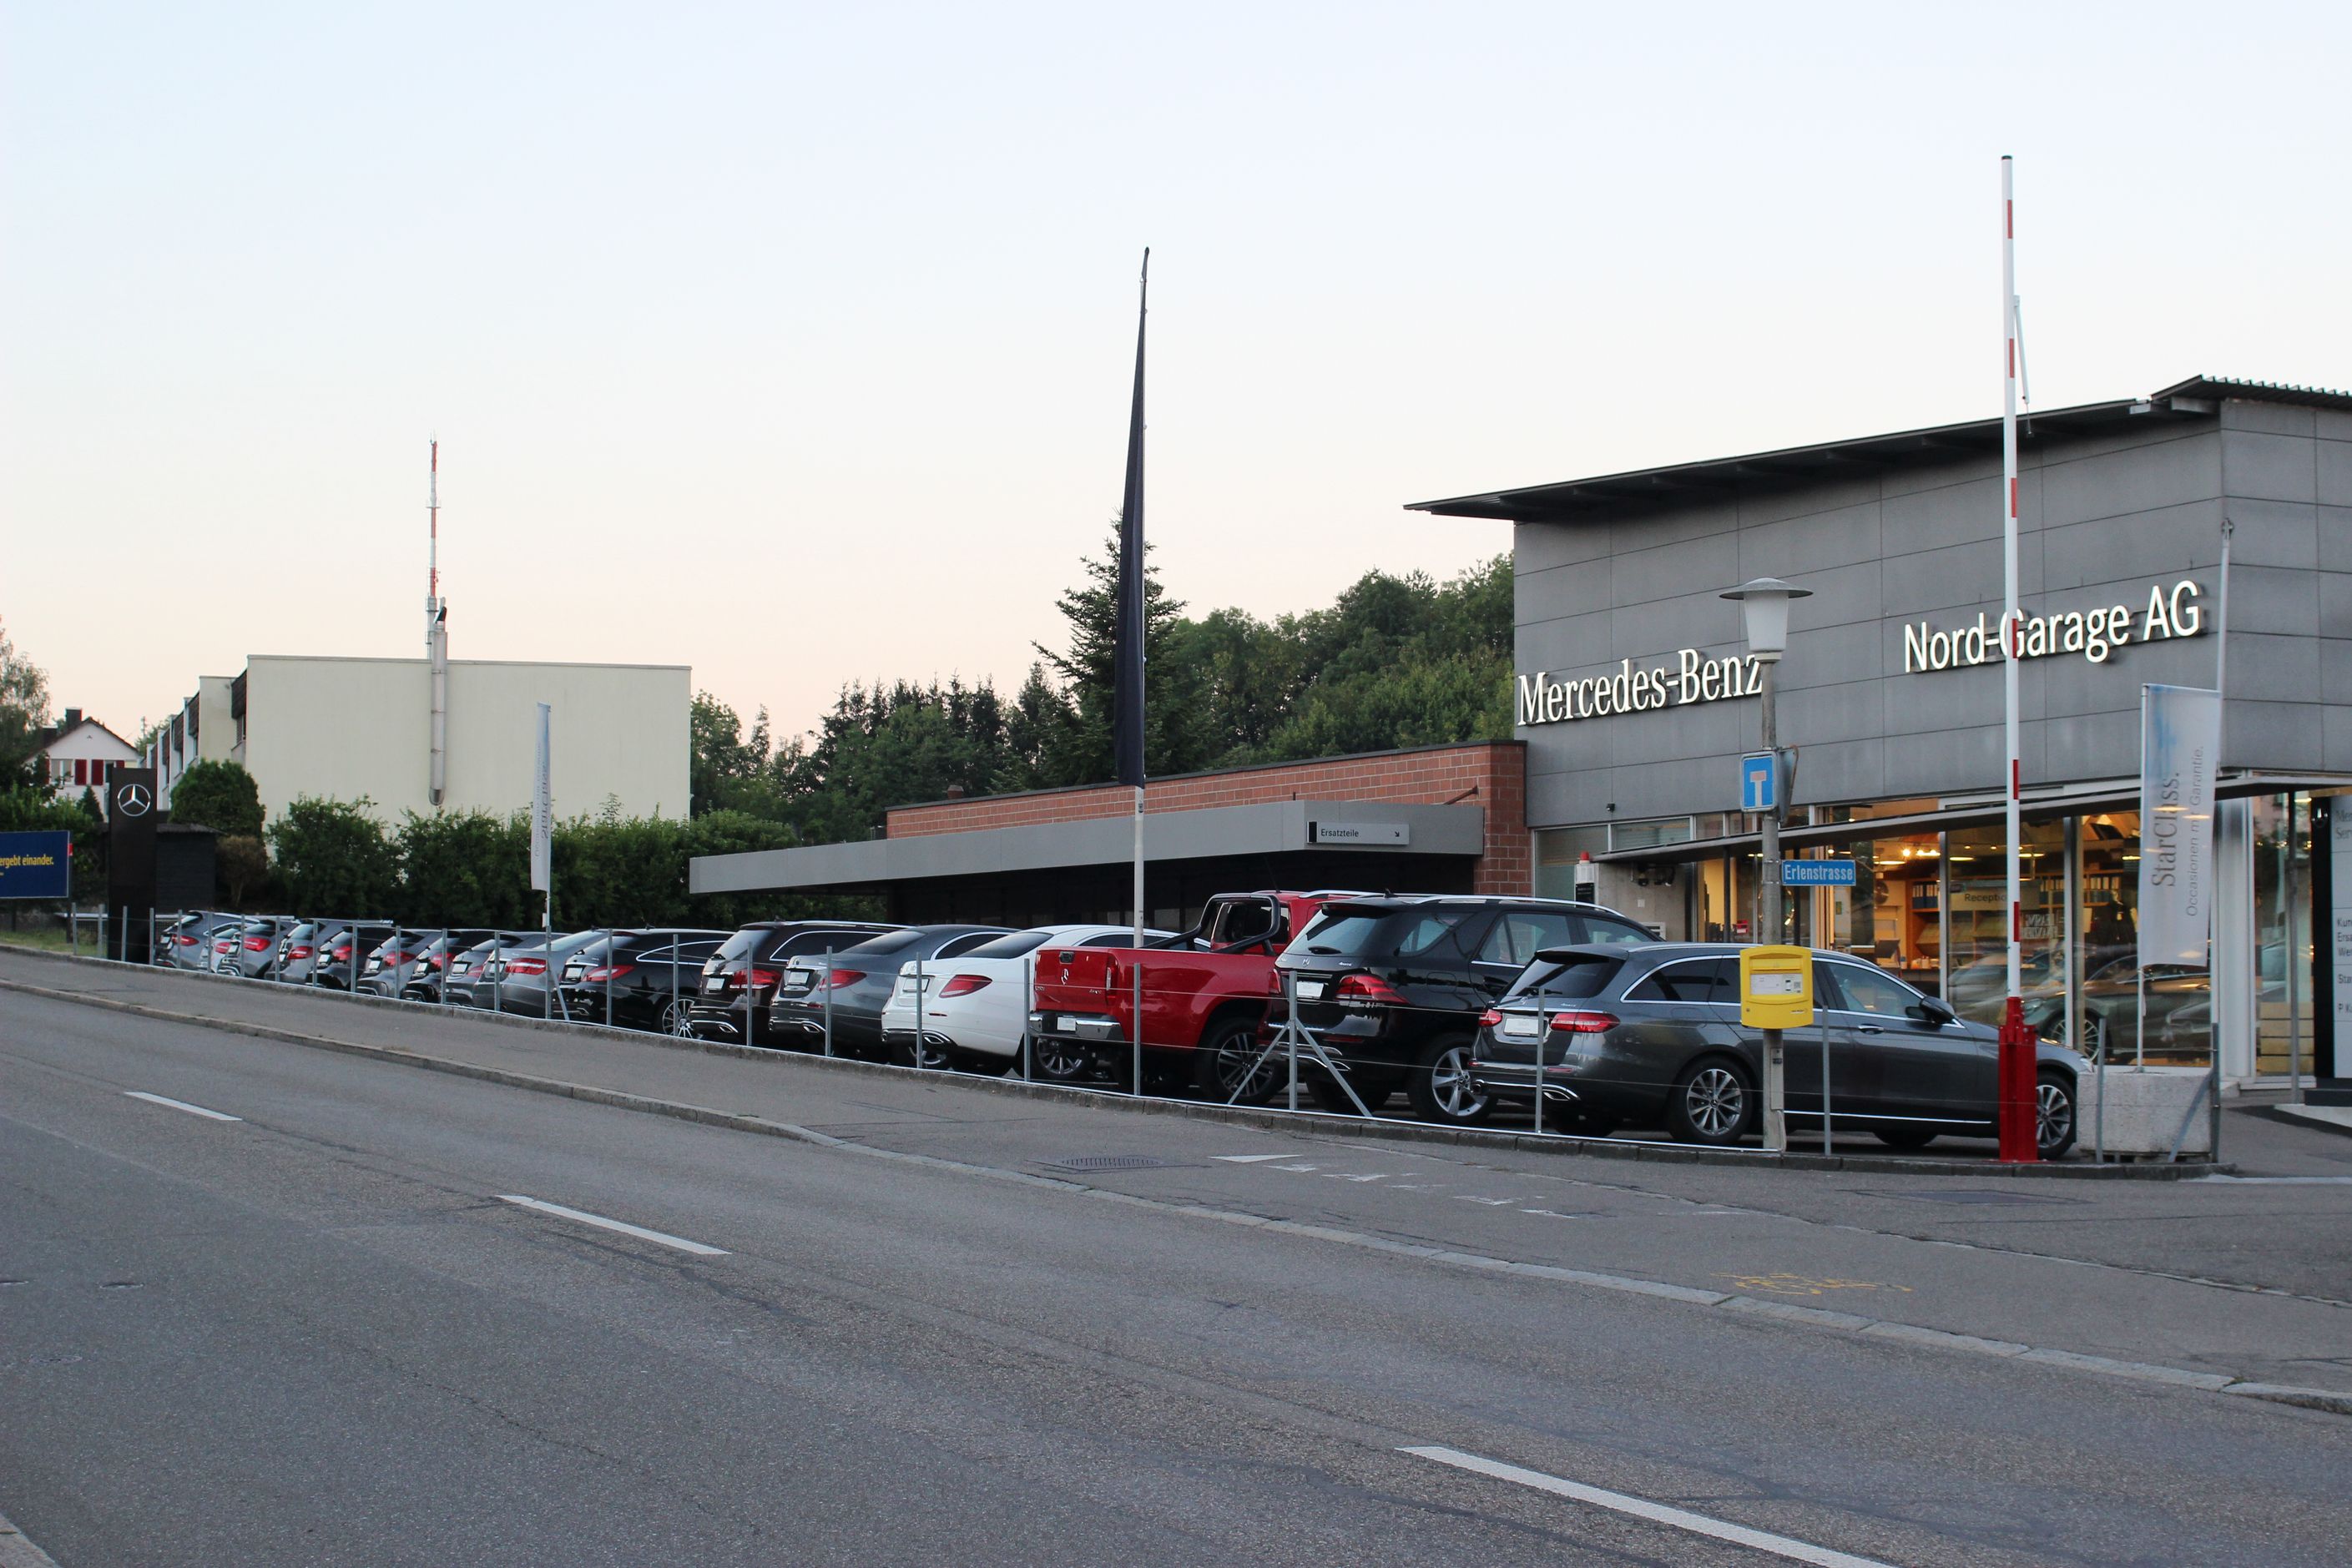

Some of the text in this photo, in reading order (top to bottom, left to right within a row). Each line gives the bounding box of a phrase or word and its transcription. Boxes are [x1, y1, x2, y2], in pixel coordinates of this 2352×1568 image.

[1904, 580, 2201, 673] Nord-Garage AG
[1517, 648, 1763, 726] Mercedes-Benz
[2189, 746, 2203, 806] Garantie.
[22, 854, 54, 866] einander.
[1320, 828, 1360, 838] Ersatzteile
[2151, 772, 2180, 887] StarClass.
[1784, 865, 1853, 880] Erlenstrasse
[2185, 834, 2200, 916] Occasionen
